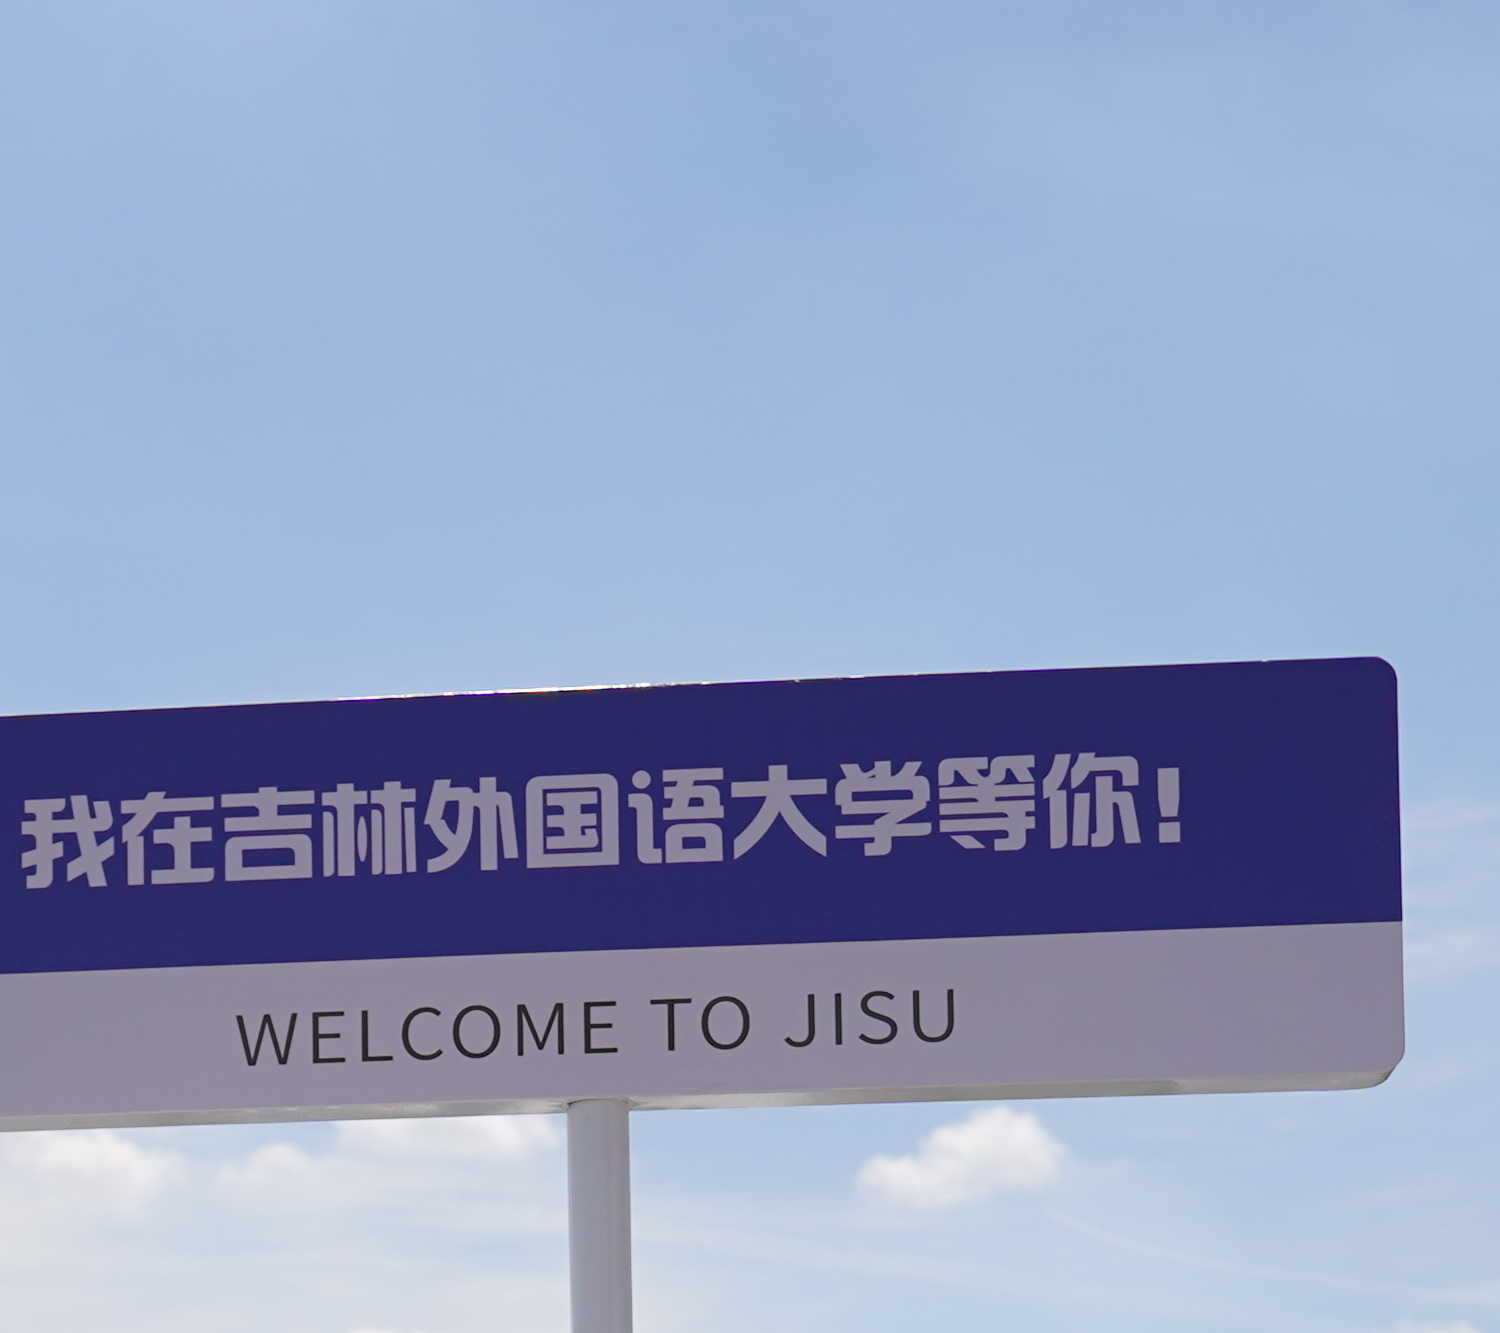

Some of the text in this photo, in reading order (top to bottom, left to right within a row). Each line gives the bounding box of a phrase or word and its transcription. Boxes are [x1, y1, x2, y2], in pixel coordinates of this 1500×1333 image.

[235, 988, 956, 1067] WELCOME TO JISU
